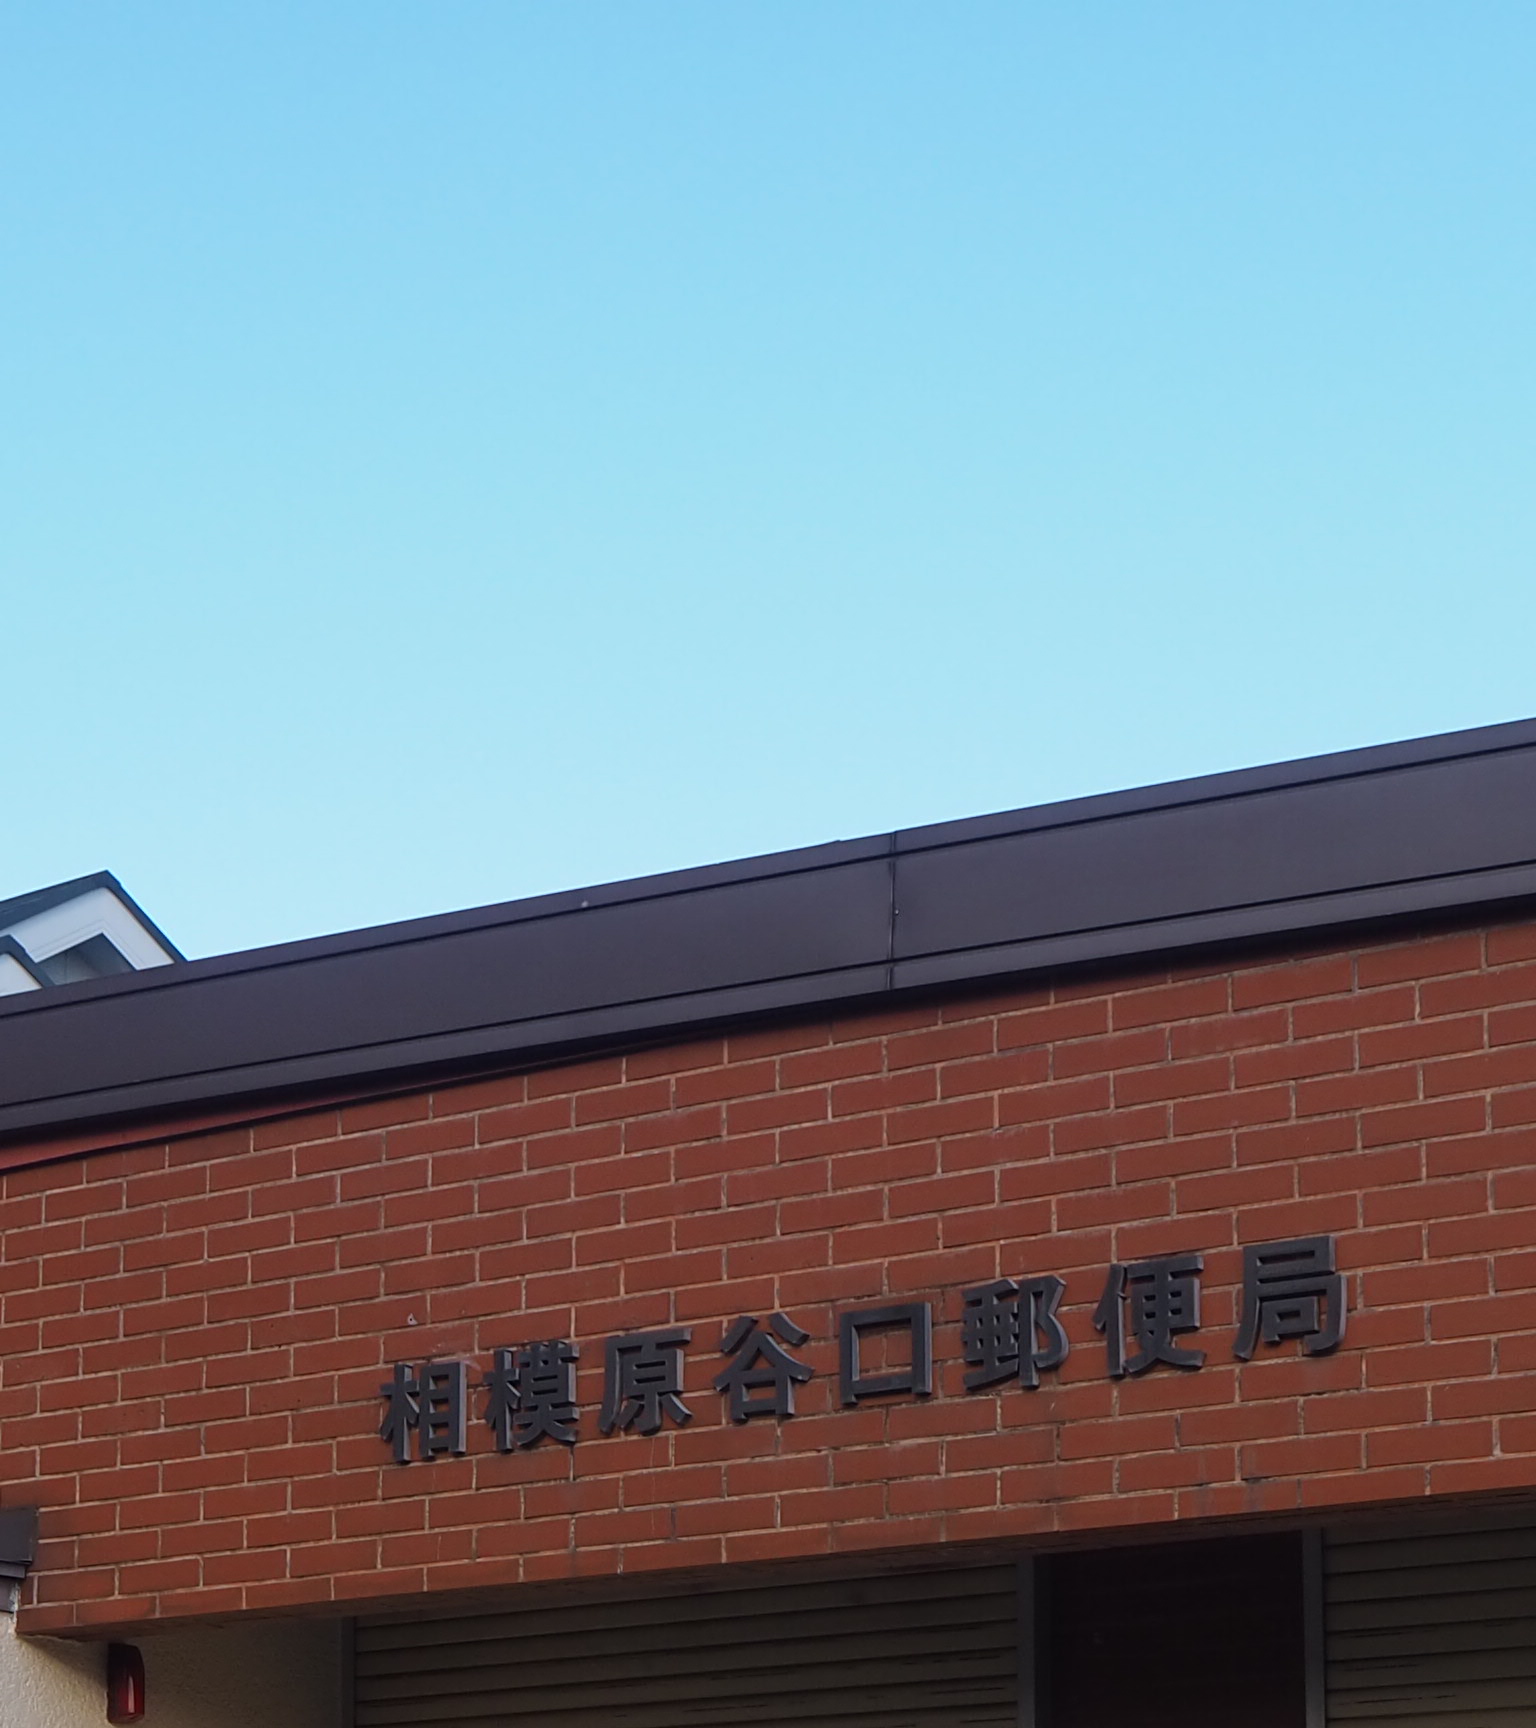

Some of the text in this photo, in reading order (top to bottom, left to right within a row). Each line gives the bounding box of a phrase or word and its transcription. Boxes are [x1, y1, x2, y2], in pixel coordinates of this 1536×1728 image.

[378, 1234, 1347, 1462] 相模原谷口郵便局
